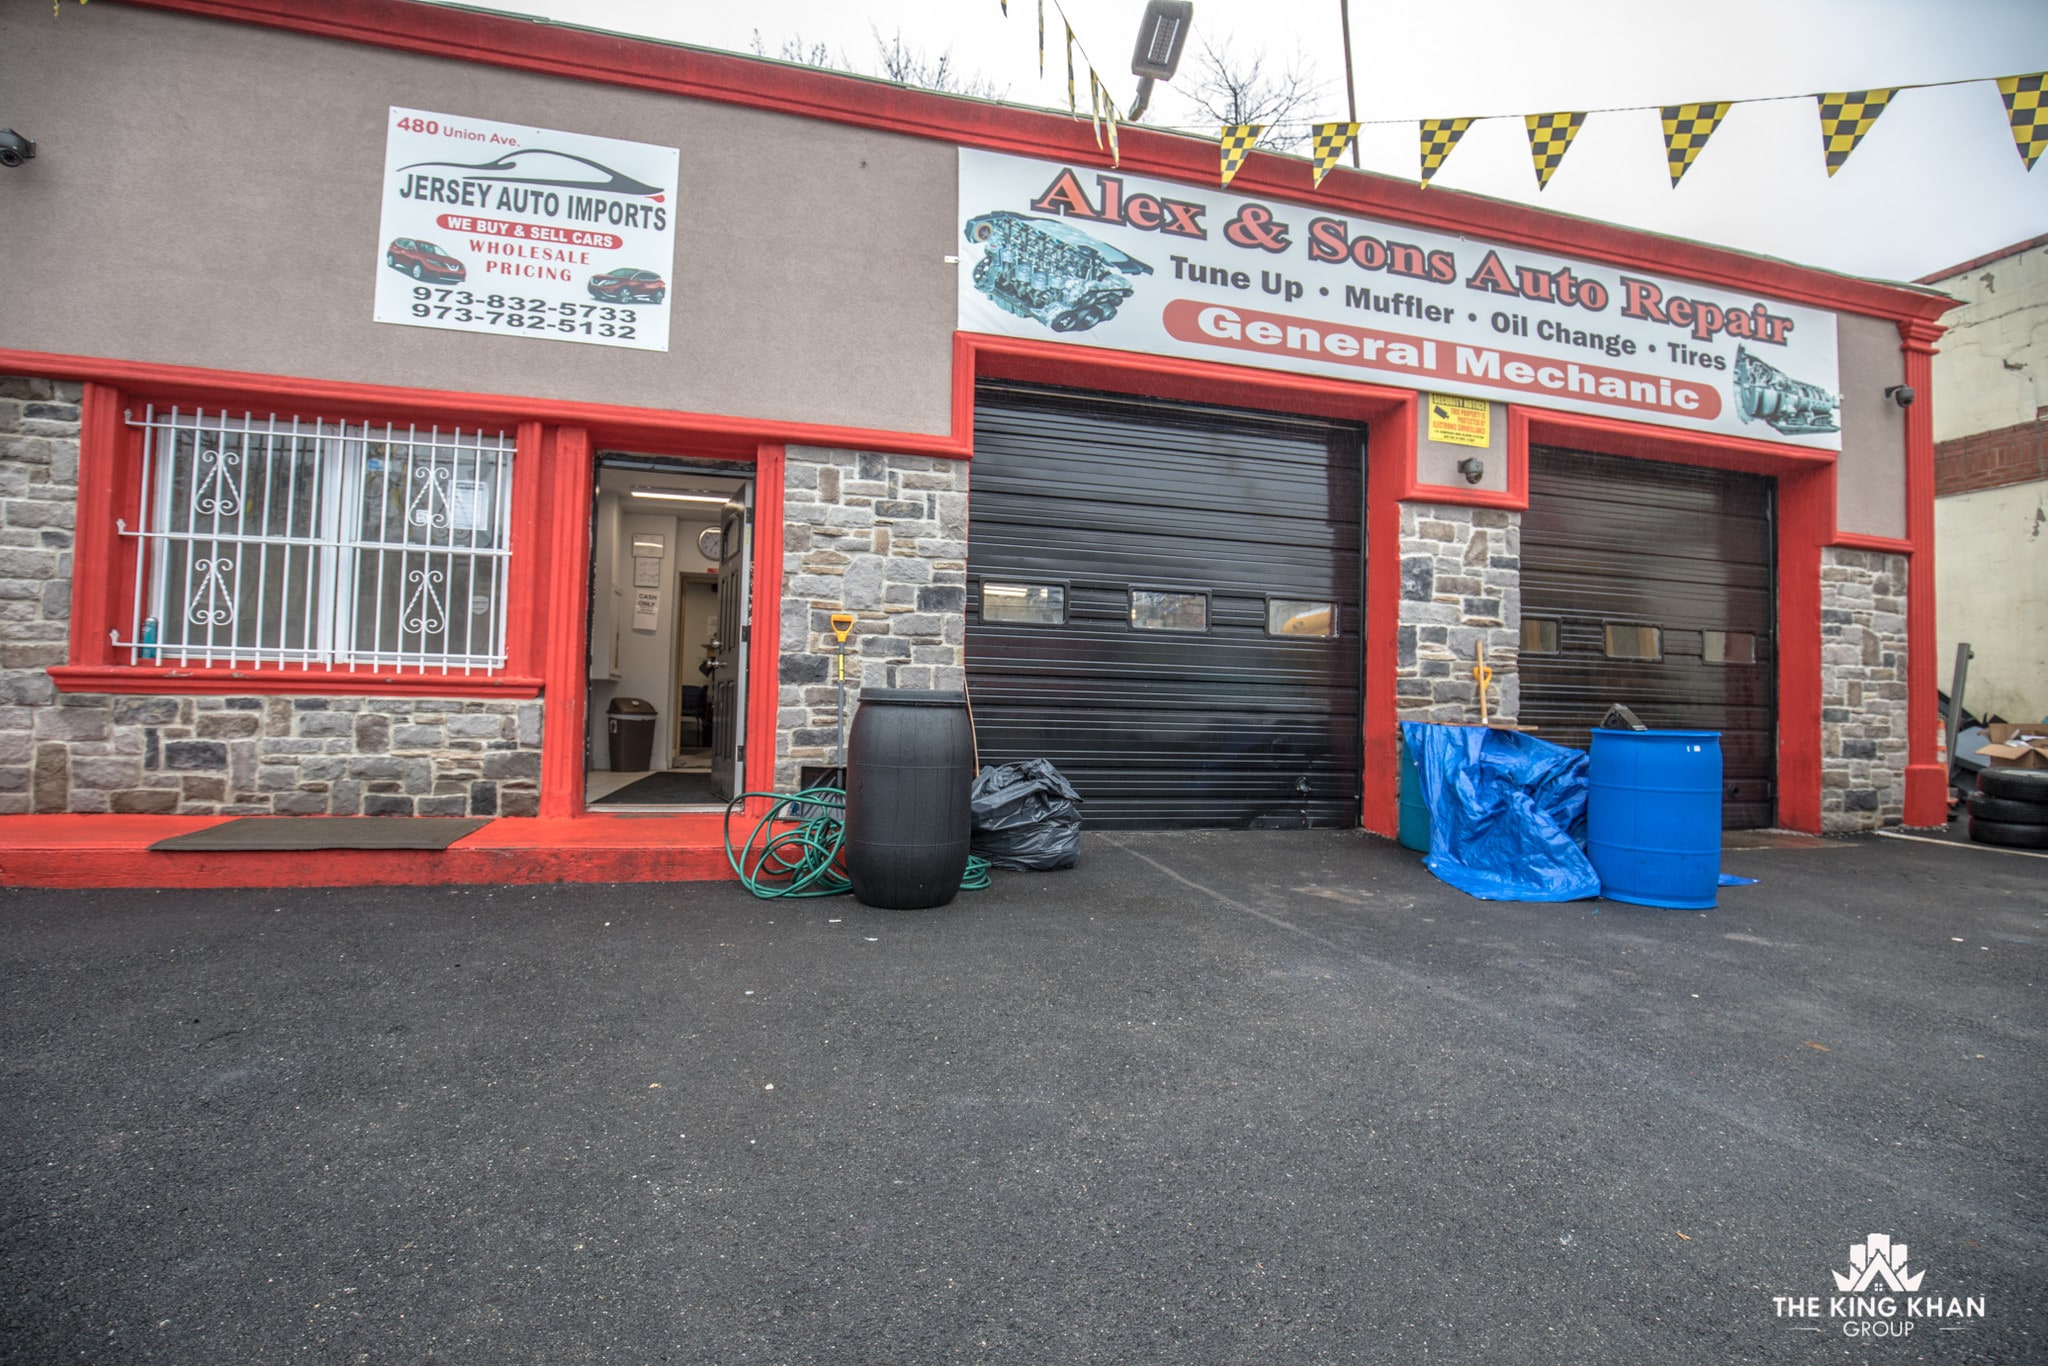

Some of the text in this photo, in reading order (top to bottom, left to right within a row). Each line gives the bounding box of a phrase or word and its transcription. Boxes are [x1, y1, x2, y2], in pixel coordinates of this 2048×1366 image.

[397, 117, 521, 147] 480 Union Ave.
[400, 174, 667, 232] JERSEY AUTO IMPORTS
[447, 216, 613, 247] WE BUY & SELL CARS
[469, 239, 591, 265] WHOLESALE
[1030, 167, 1794, 346] Alex & Sons Auto Repair
[486, 260, 572, 282] PRICING
[411, 303, 636, 339] 973-782-5132
[412, 286, 637, 323] 973-832-5733
[1170, 255, 1727, 371] Tune Up Muffler Oil Change Tires
[1198, 306, 1701, 410] General Mechanic
